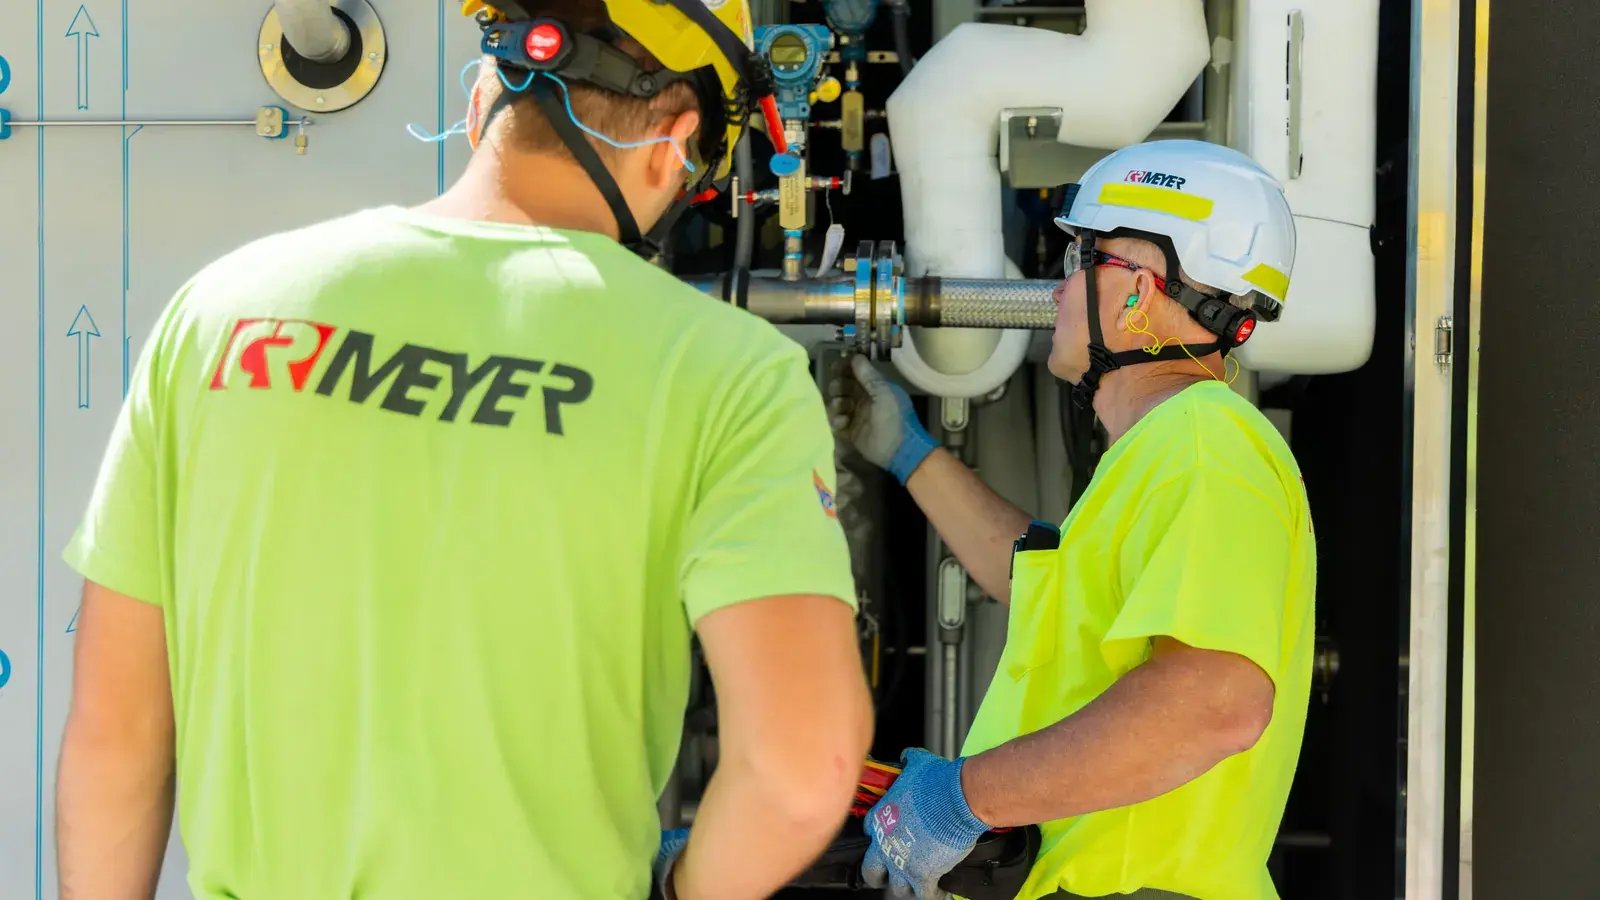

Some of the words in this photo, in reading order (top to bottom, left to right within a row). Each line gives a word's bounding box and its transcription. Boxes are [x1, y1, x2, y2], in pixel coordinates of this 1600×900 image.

[1141, 171, 1186, 190] MEYER
[314, 329, 594, 437] MEYER
[883, 804, 897, 826] A6
